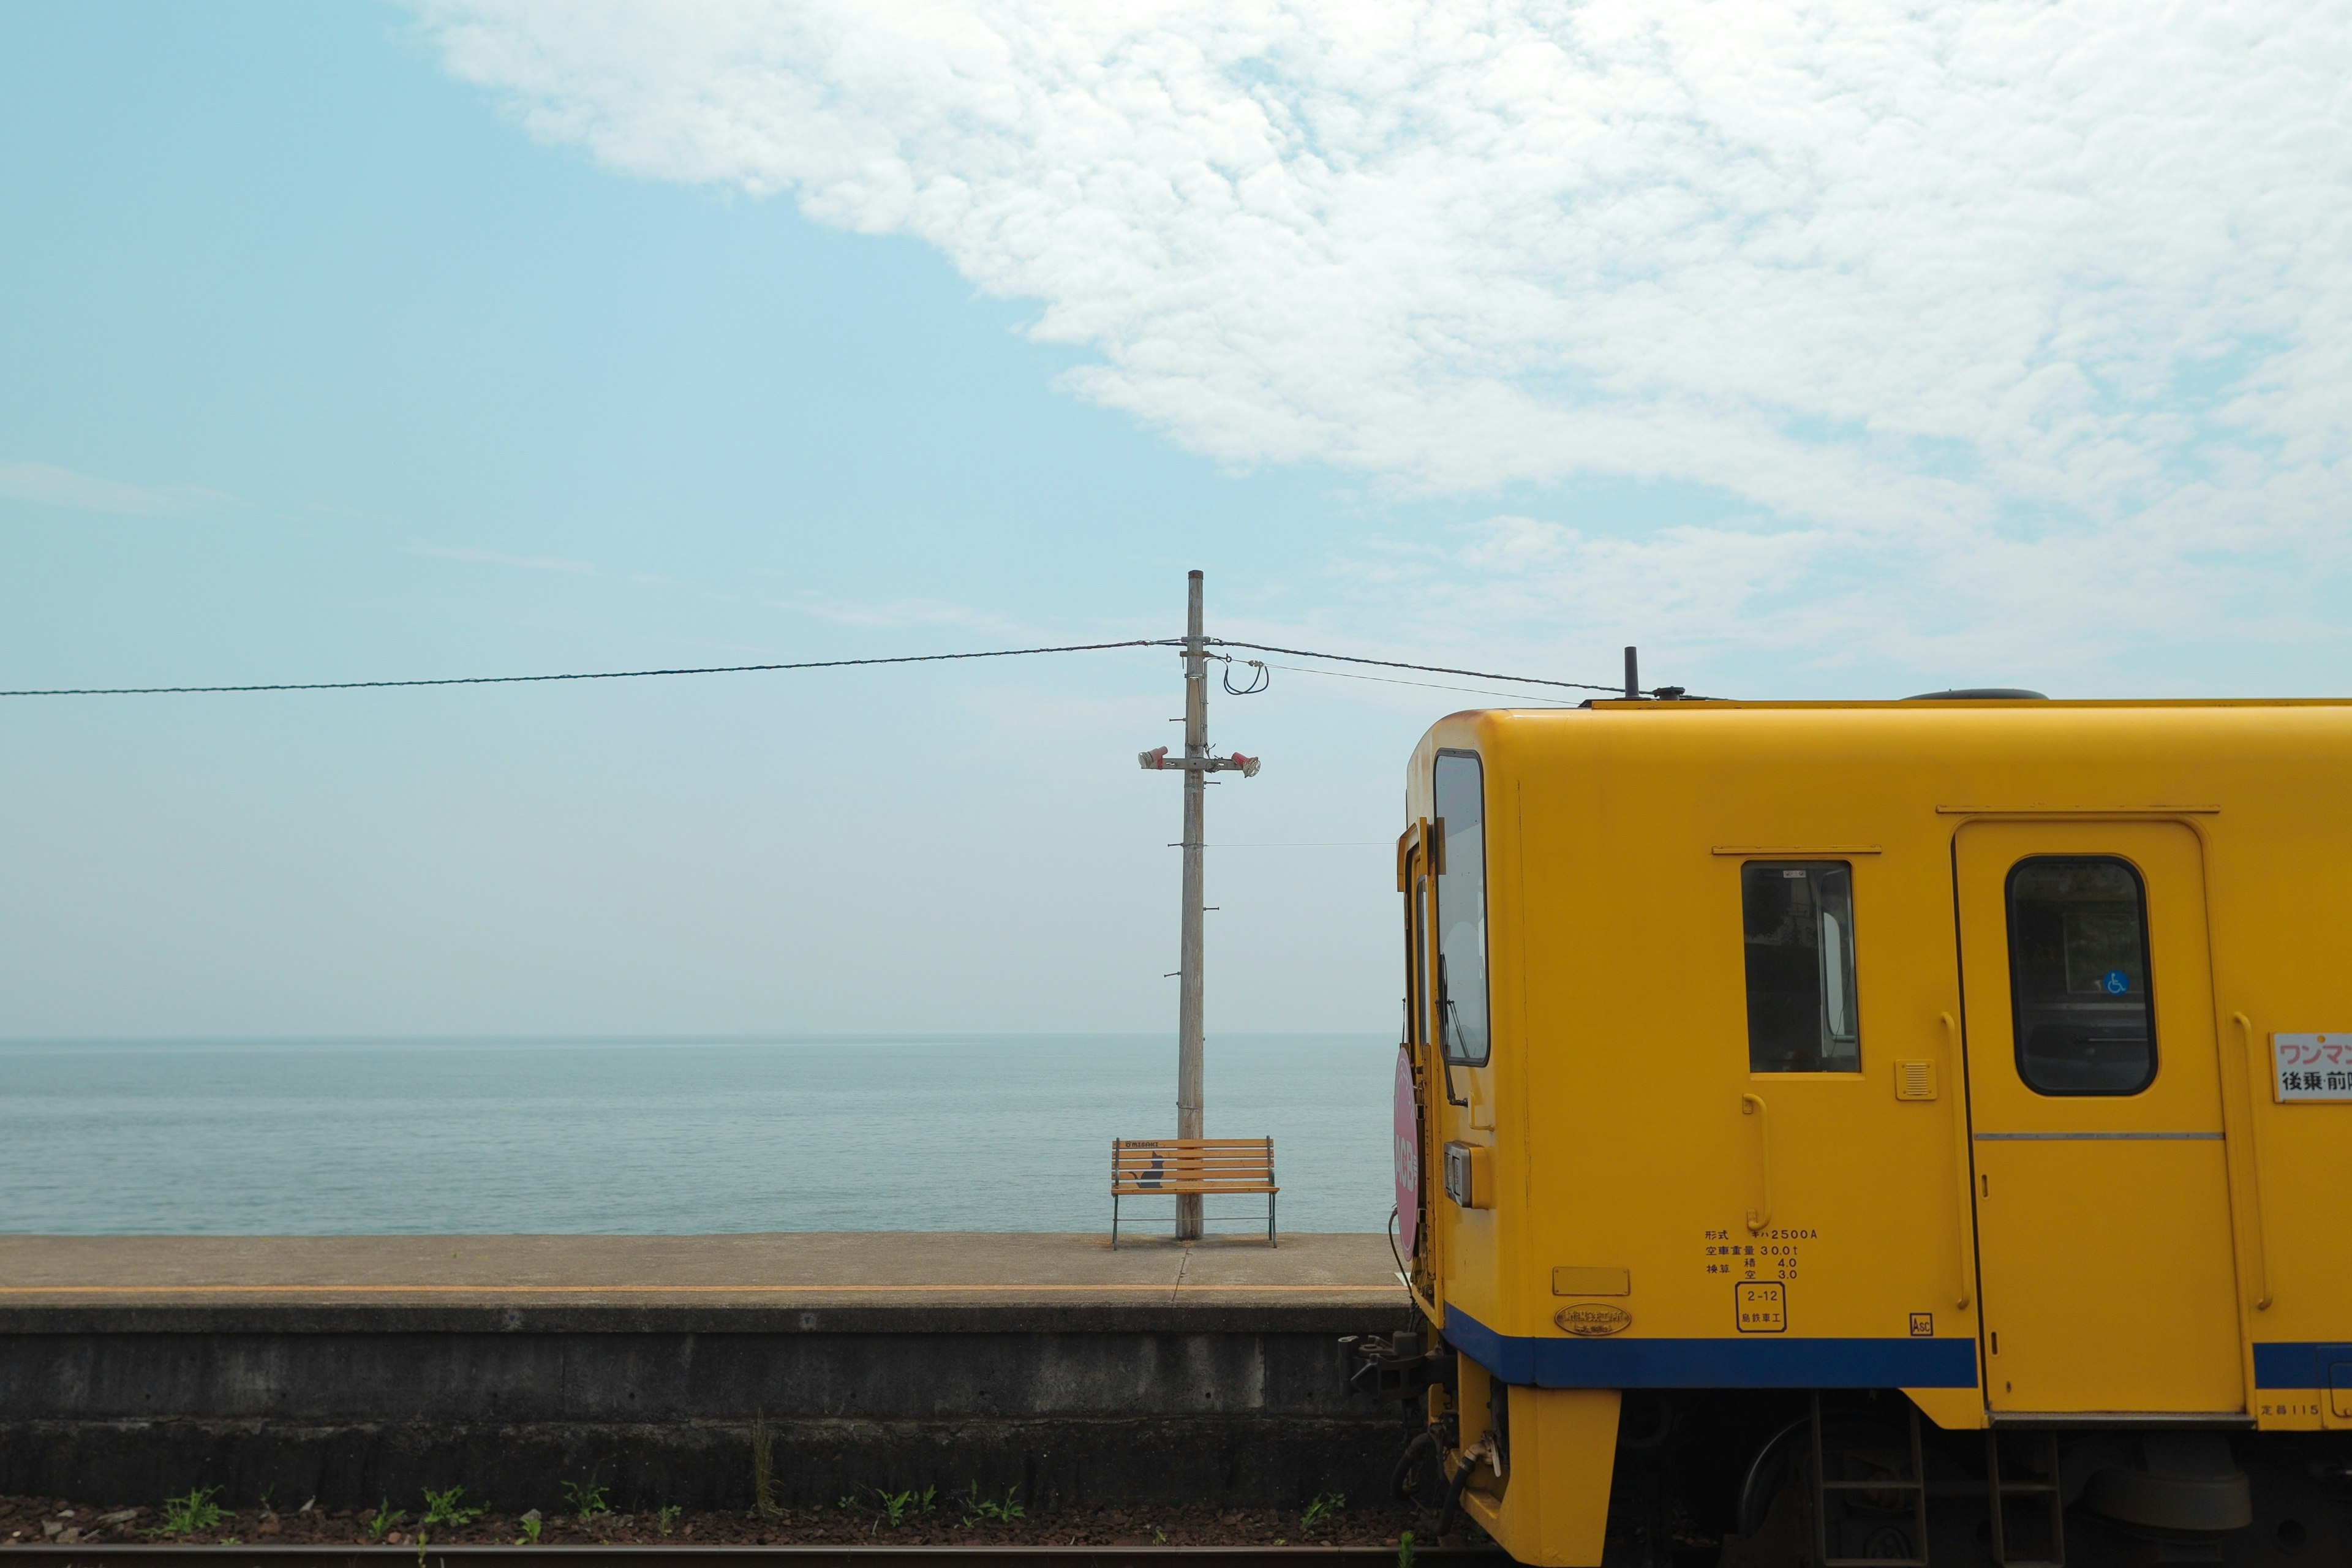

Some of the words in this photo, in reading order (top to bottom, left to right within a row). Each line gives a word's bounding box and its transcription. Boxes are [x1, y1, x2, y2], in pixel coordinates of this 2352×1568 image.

[2282, 1071, 2352, 1090] 後乗・前
[1705, 1230, 1728, 1240] 形式
[1705, 1245, 1755, 1256] 空車重量
[1777, 1258, 1796, 1267] 4.0
[1706, 1264, 1730, 1273] 換算
[1744, 1270, 1756, 1280] 空
[1777, 1270, 1797, 1280] 3.0
[1747, 1291, 1778, 1301] 2-12
